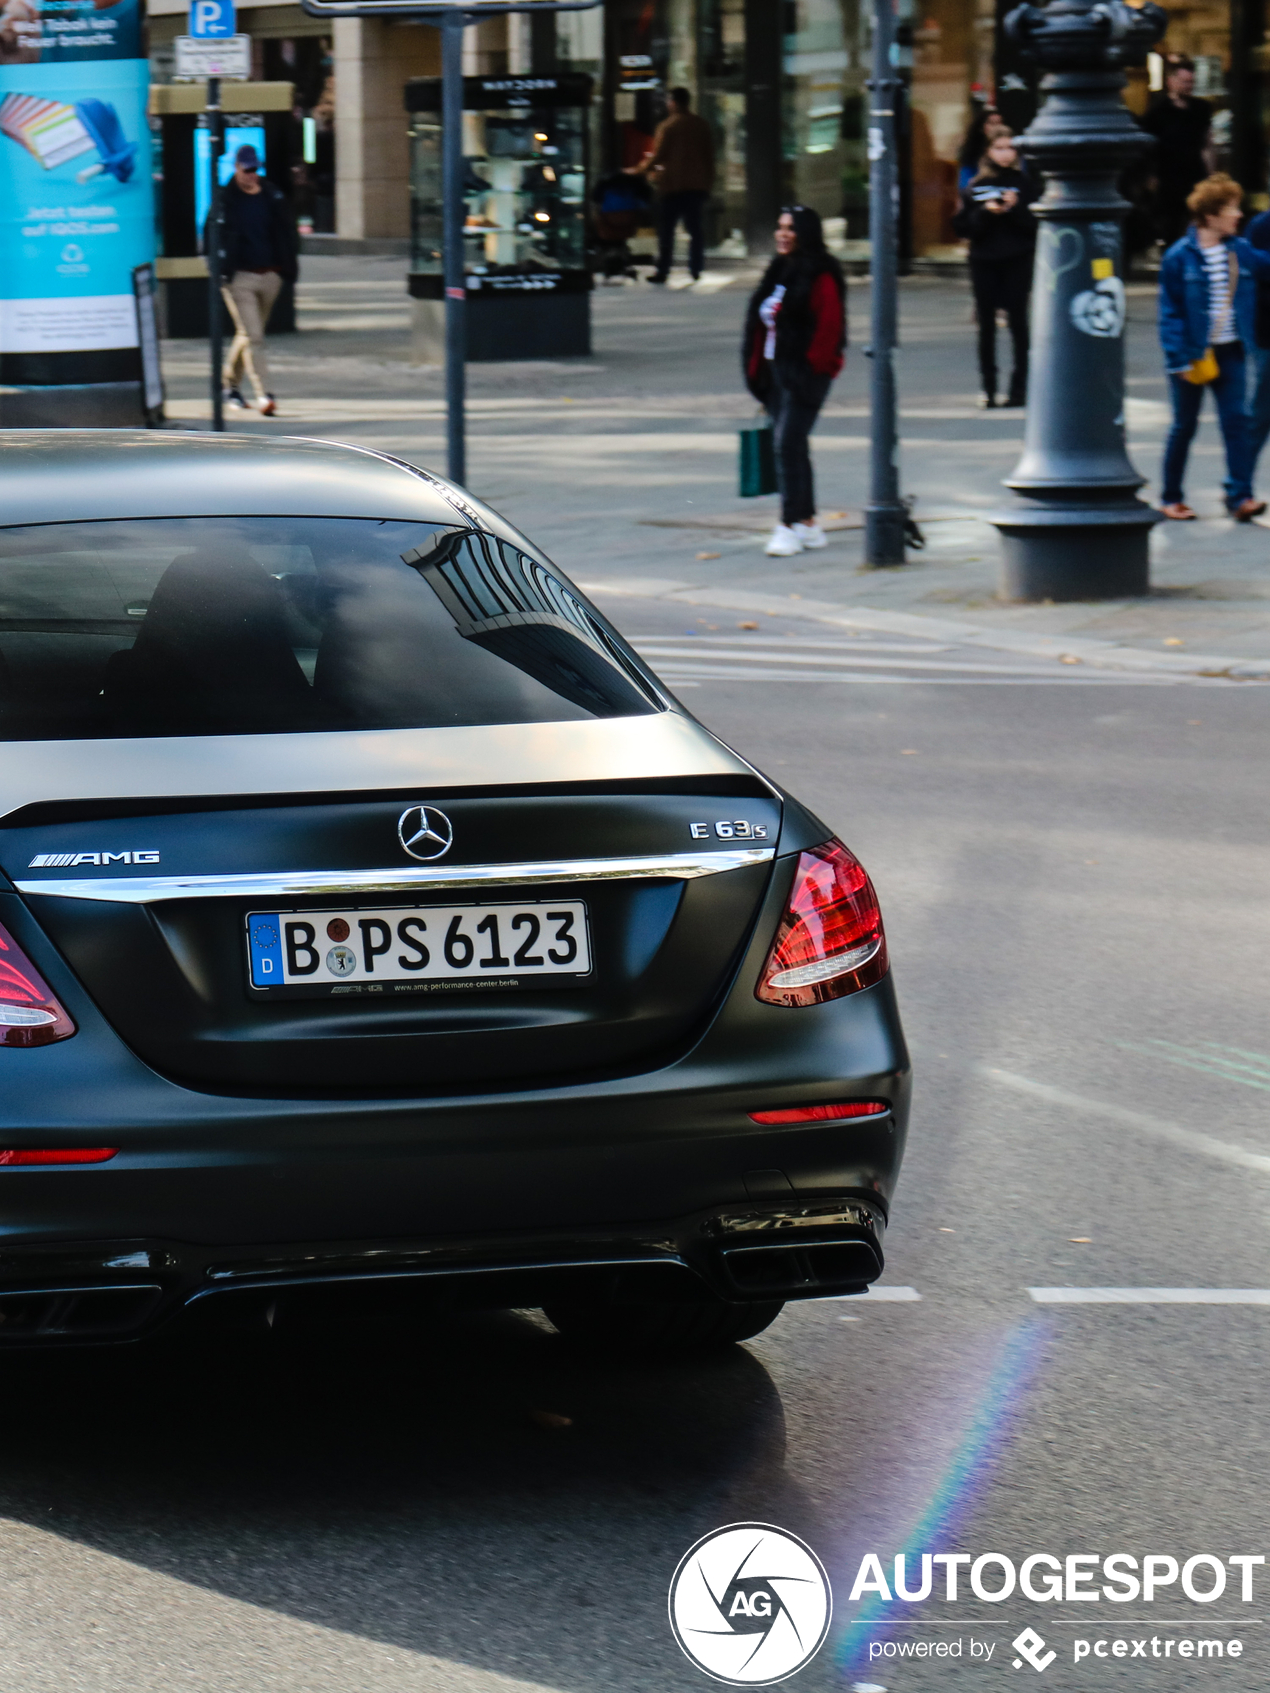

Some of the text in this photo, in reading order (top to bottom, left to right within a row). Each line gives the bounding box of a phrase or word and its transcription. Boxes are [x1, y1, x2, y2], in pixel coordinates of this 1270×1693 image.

[195, 1, 222, 34] P
[690, 822, 710, 839] E
[69, 850, 160, 866] AMG
[284, 911, 579, 976] B PS 6123
[261, 958, 274, 974] D
[394, 979, 519, 993] www.amg-performance-center.berlin
